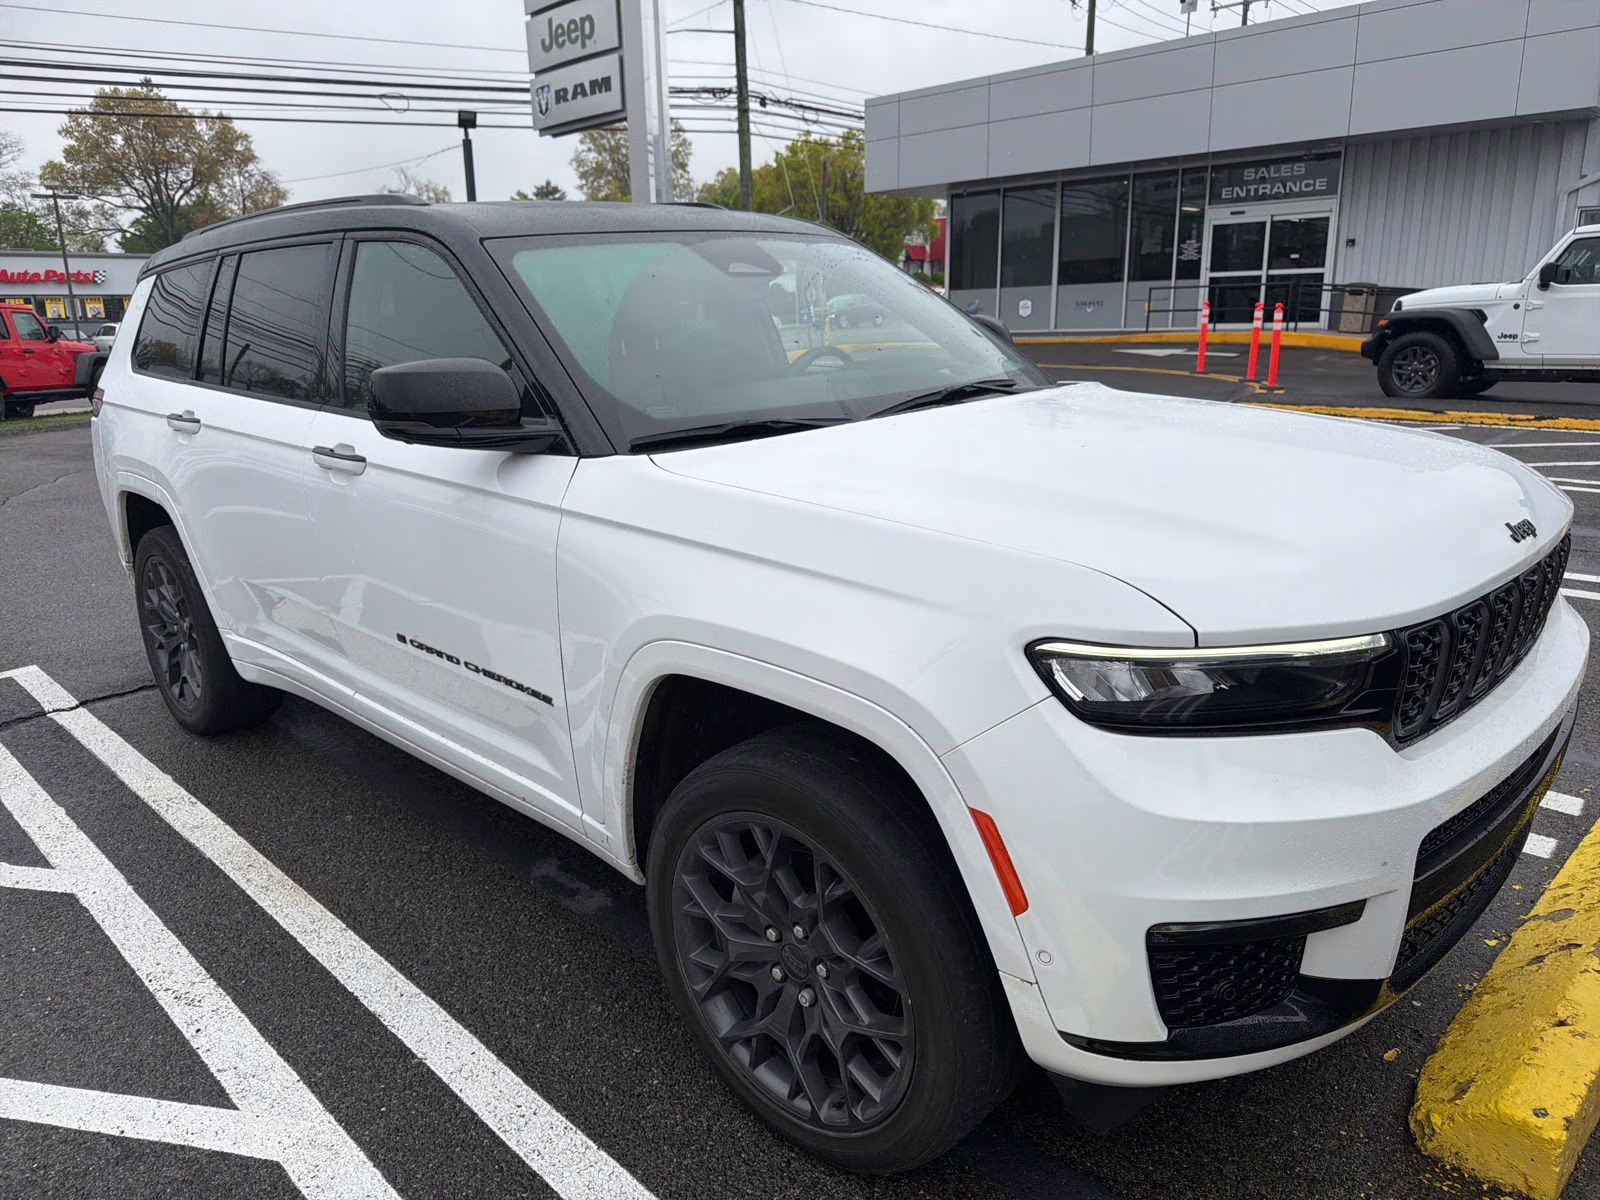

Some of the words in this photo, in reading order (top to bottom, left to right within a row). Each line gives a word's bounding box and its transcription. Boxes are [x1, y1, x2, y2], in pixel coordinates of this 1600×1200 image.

[541, 14, 595, 53] Jeep
[554, 76, 612, 105] RAM
[1243, 163, 1306, 180] SALES
[1221, 178, 1328, 199] ENTRANCE
[0, 269, 42, 283] Auto
[44, 269, 92, 284] Parts
[1497, 332, 1518, 340] Jeep
[1504, 518, 1537, 543] Jeep
[409, 638, 461, 665] GRAND
[463, 661, 554, 706] CHEROKEE
